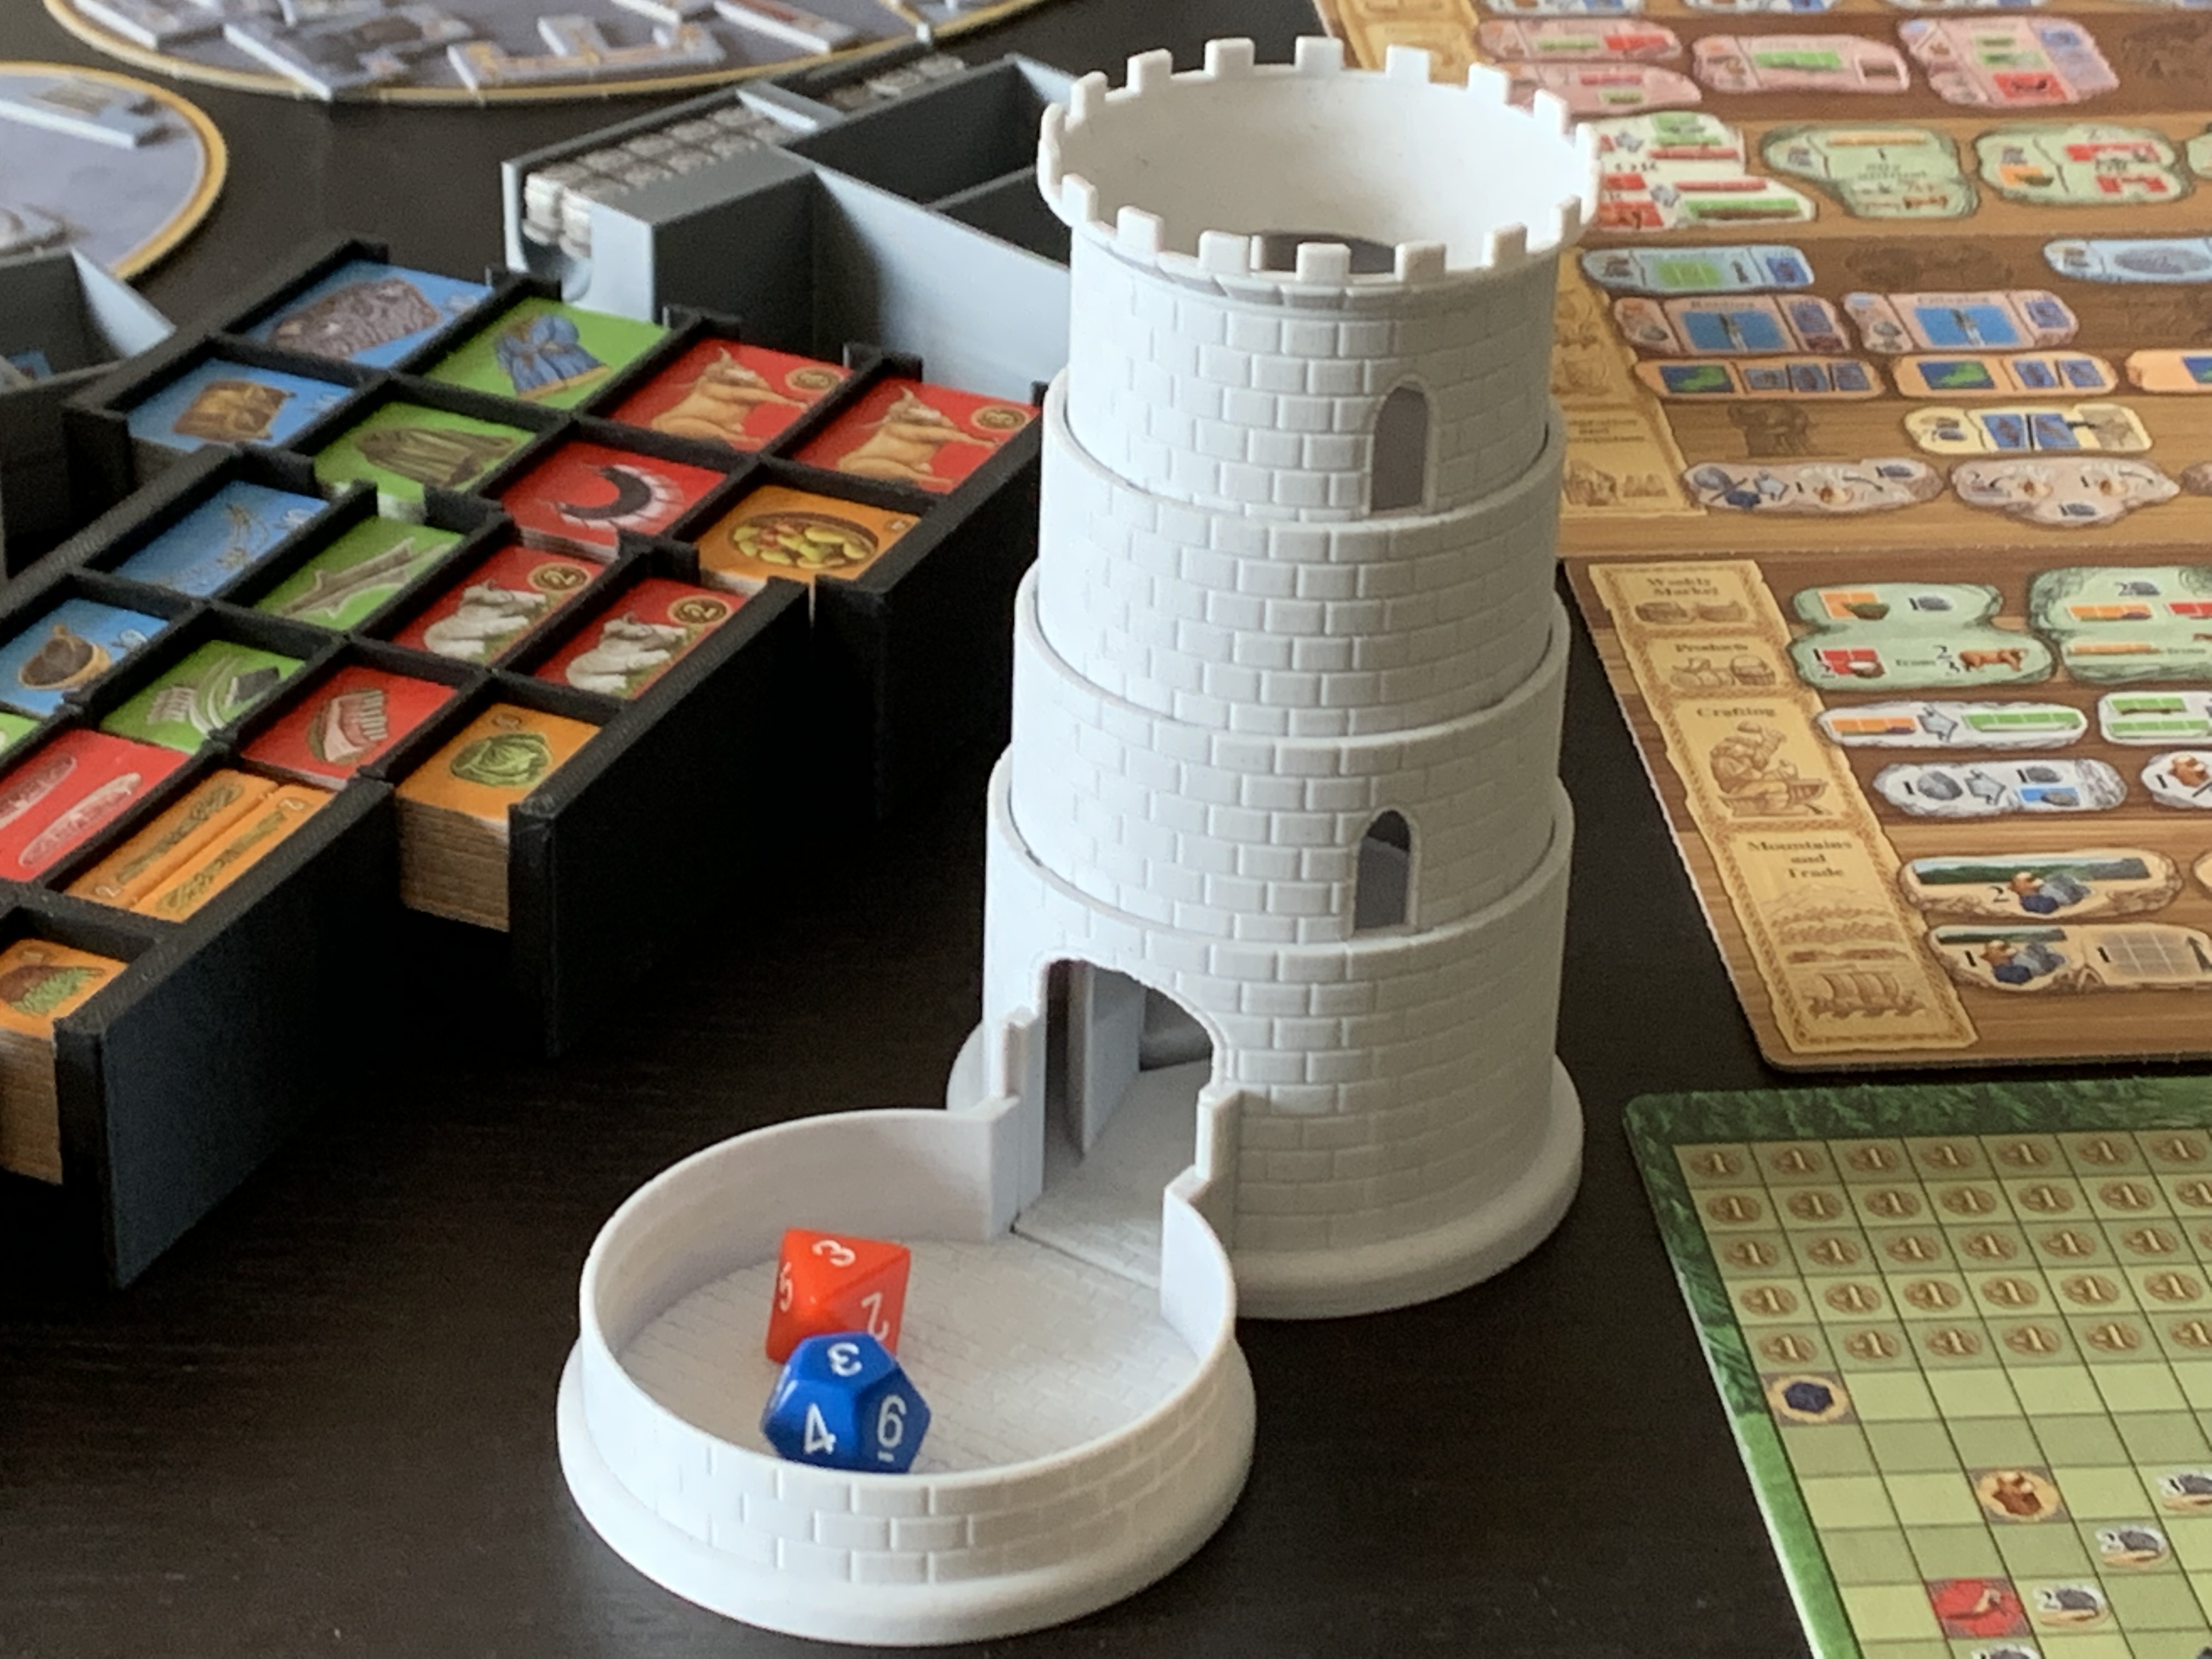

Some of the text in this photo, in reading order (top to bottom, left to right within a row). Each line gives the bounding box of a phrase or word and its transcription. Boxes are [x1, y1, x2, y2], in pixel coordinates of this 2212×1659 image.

[1696, 707, 1775, 718] Crafting
[1747, 841, 1853, 851] Mountains
[1790, 853, 1826, 864] and
[1788, 867, 1844, 879] Trade
[1988, 885, 2010, 903] 2
[827, 1342, 862, 1376] 3
[804, 1402, 836, 1454] 4
